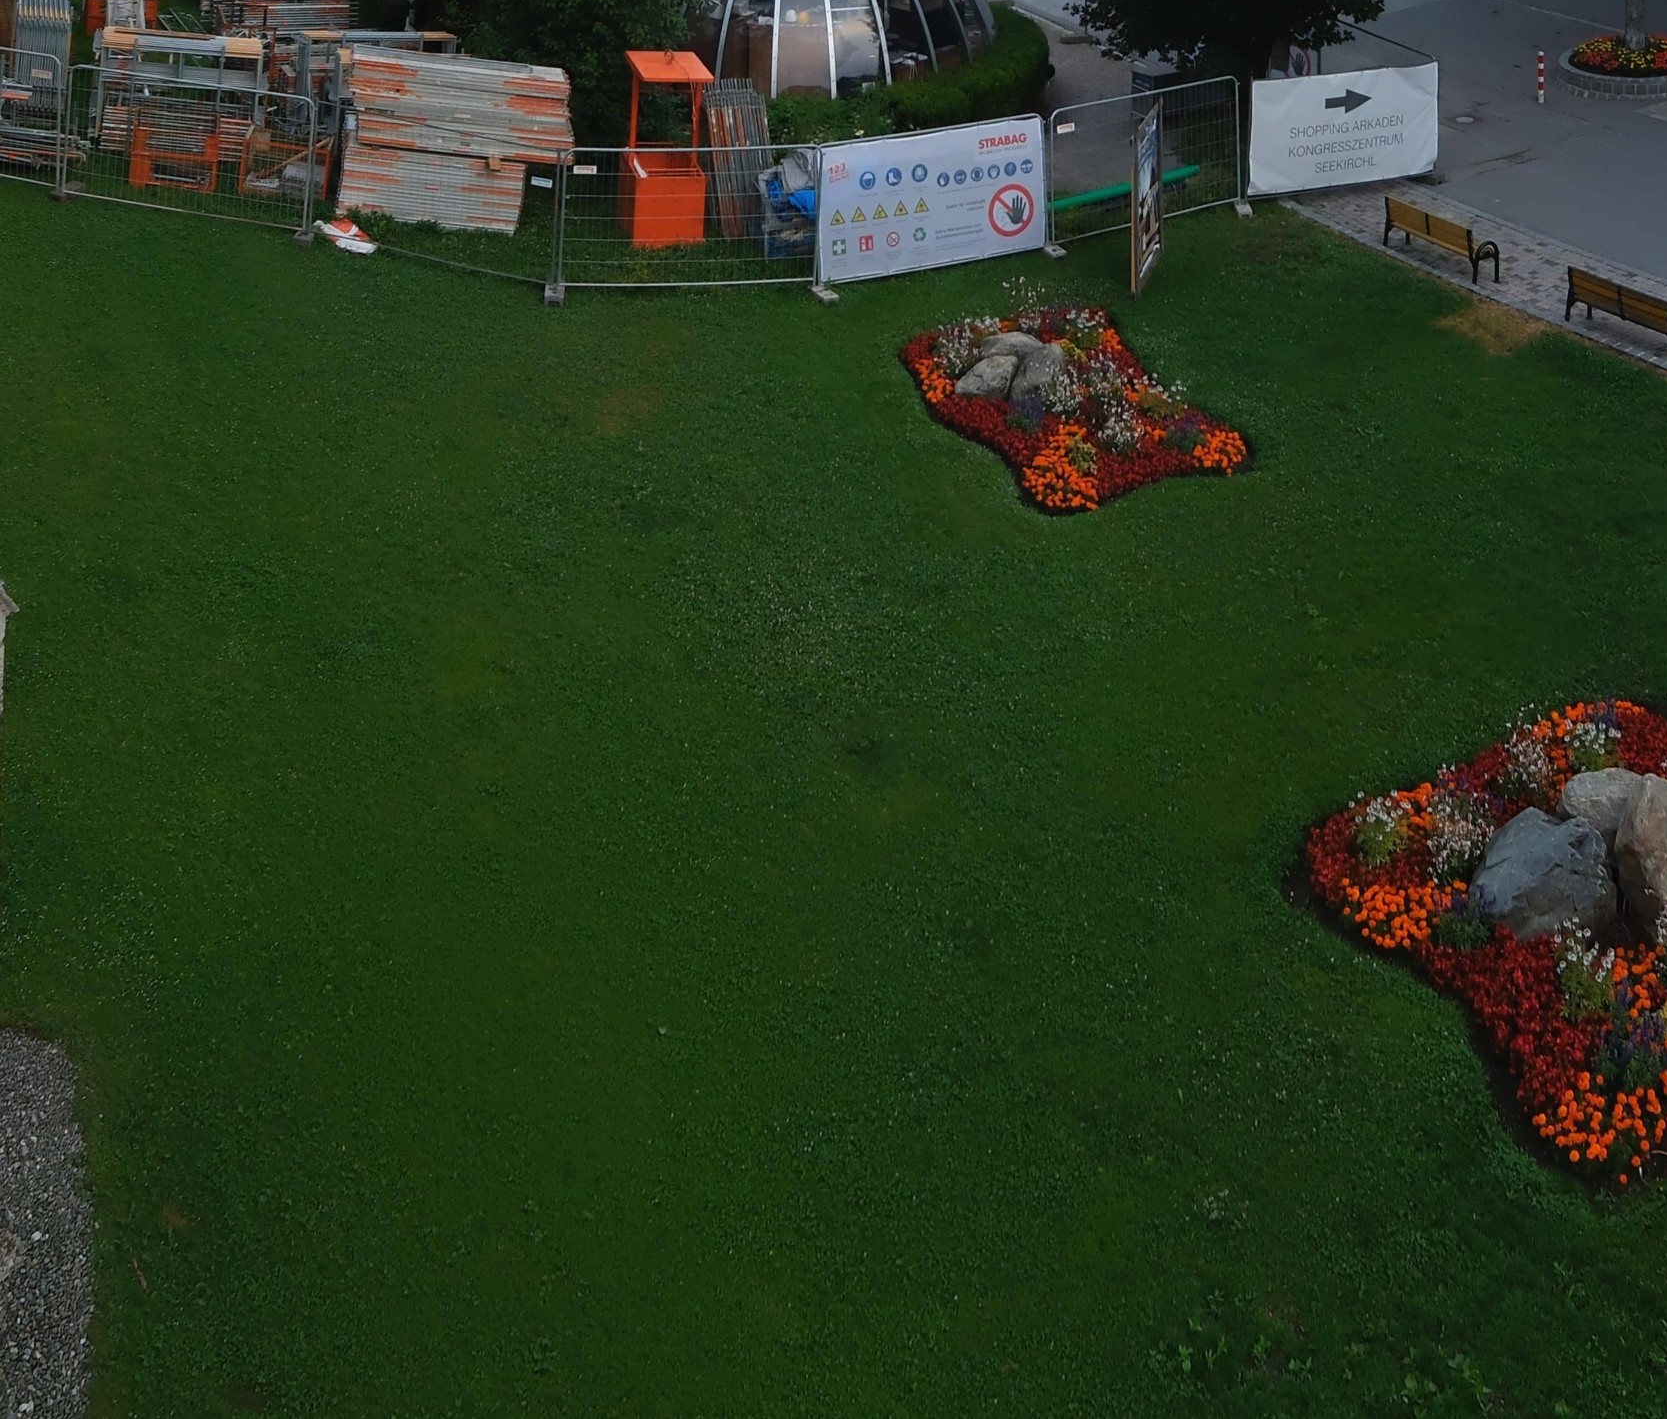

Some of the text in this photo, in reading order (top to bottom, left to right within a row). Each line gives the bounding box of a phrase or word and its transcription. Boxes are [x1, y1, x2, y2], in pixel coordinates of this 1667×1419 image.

[1289, 115, 1404, 139] SHOPPING ARKADEN
[978, 133, 1027, 149] STRABAG
[1288, 133, 1404, 157] KONGRESSZENTRUM
[1315, 156, 1376, 174] SEEKIRCHL
